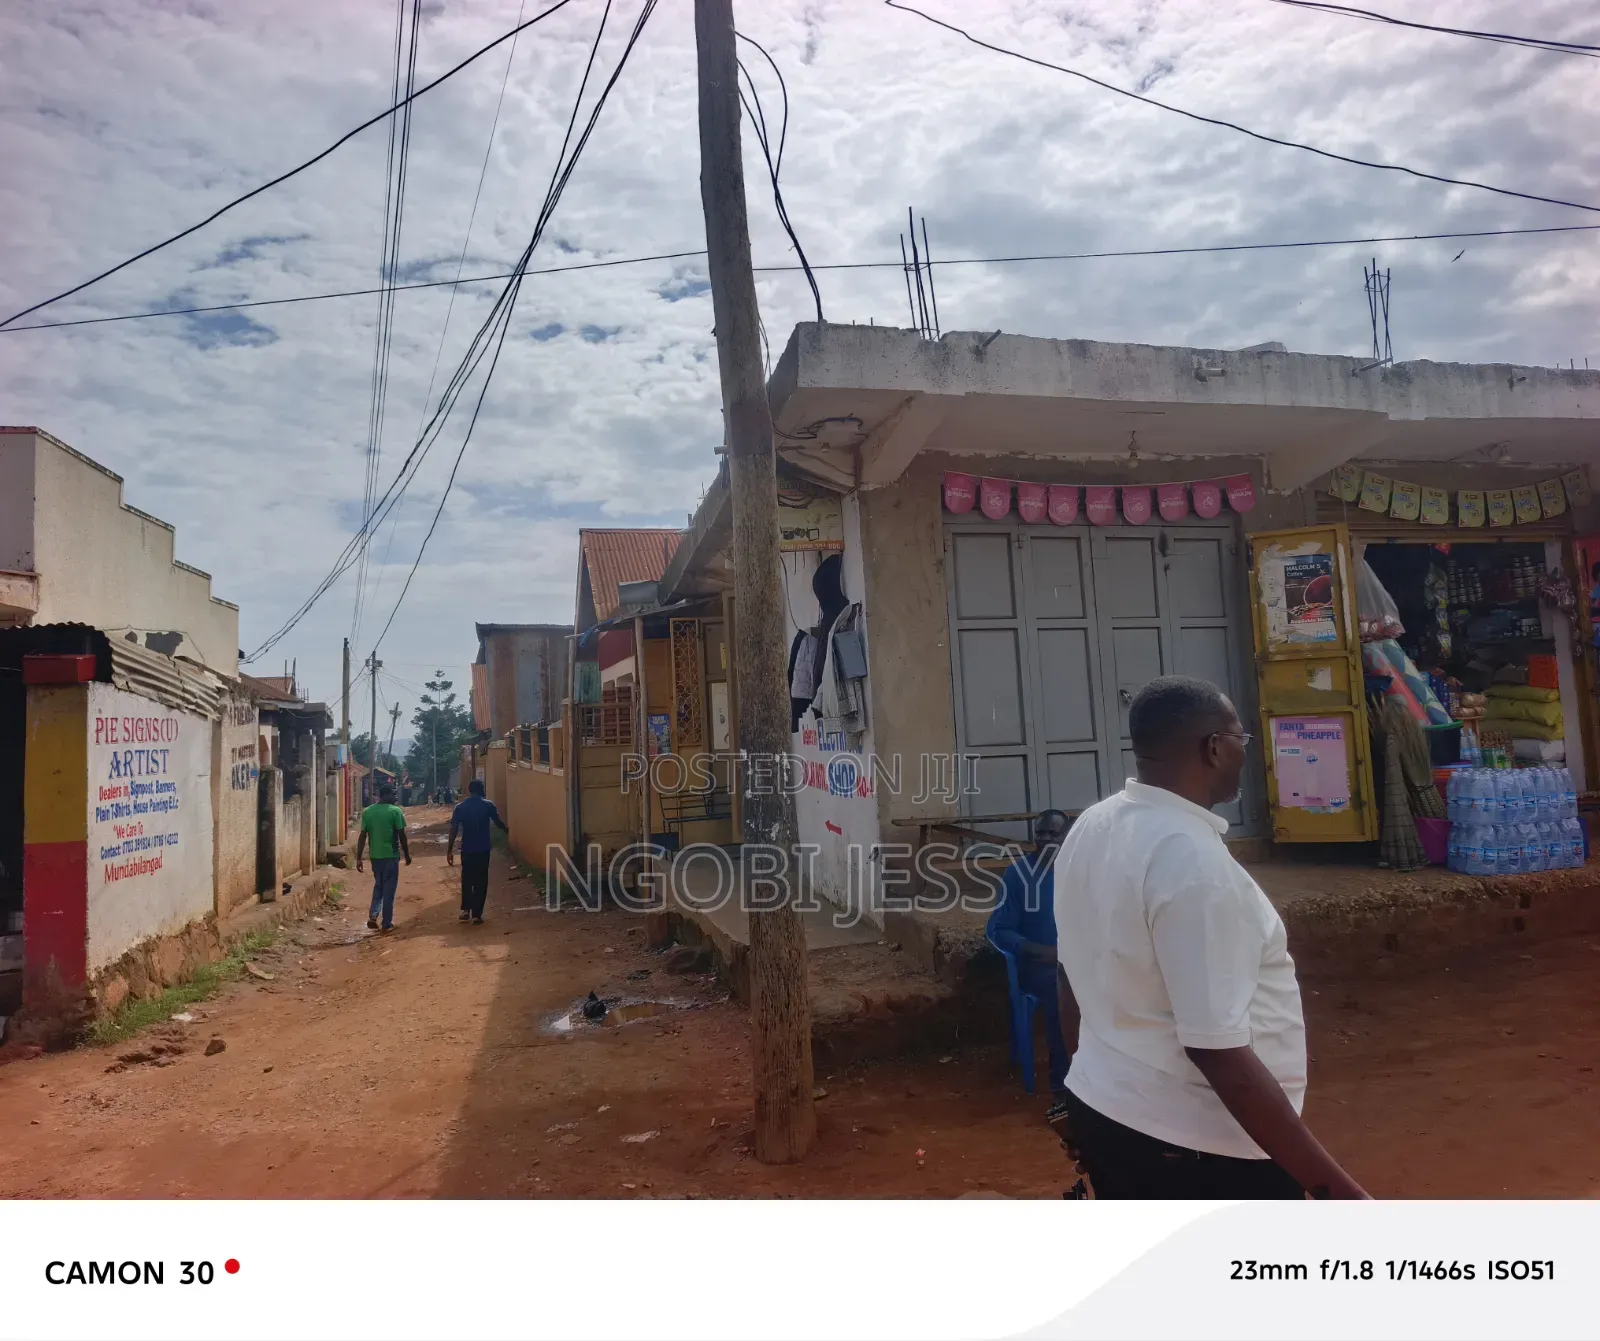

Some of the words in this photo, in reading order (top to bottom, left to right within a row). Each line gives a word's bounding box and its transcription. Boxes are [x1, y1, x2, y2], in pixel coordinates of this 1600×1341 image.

[95, 717, 118, 745] PIE
[123, 717, 179, 743] SIGNS(U)
[1280, 722, 1305, 731] FANTA
[1297, 731, 1341, 740] PINEAPPLE
[108, 748, 170, 780] ARTIST
[828, 762, 856, 798] SHOP
[99, 784, 122, 802] Dealers
[95, 806, 110, 823] Plain
[133, 800, 148, 815] House
[149, 797, 168, 814] Painting
[126, 823, 137, 838] Care
